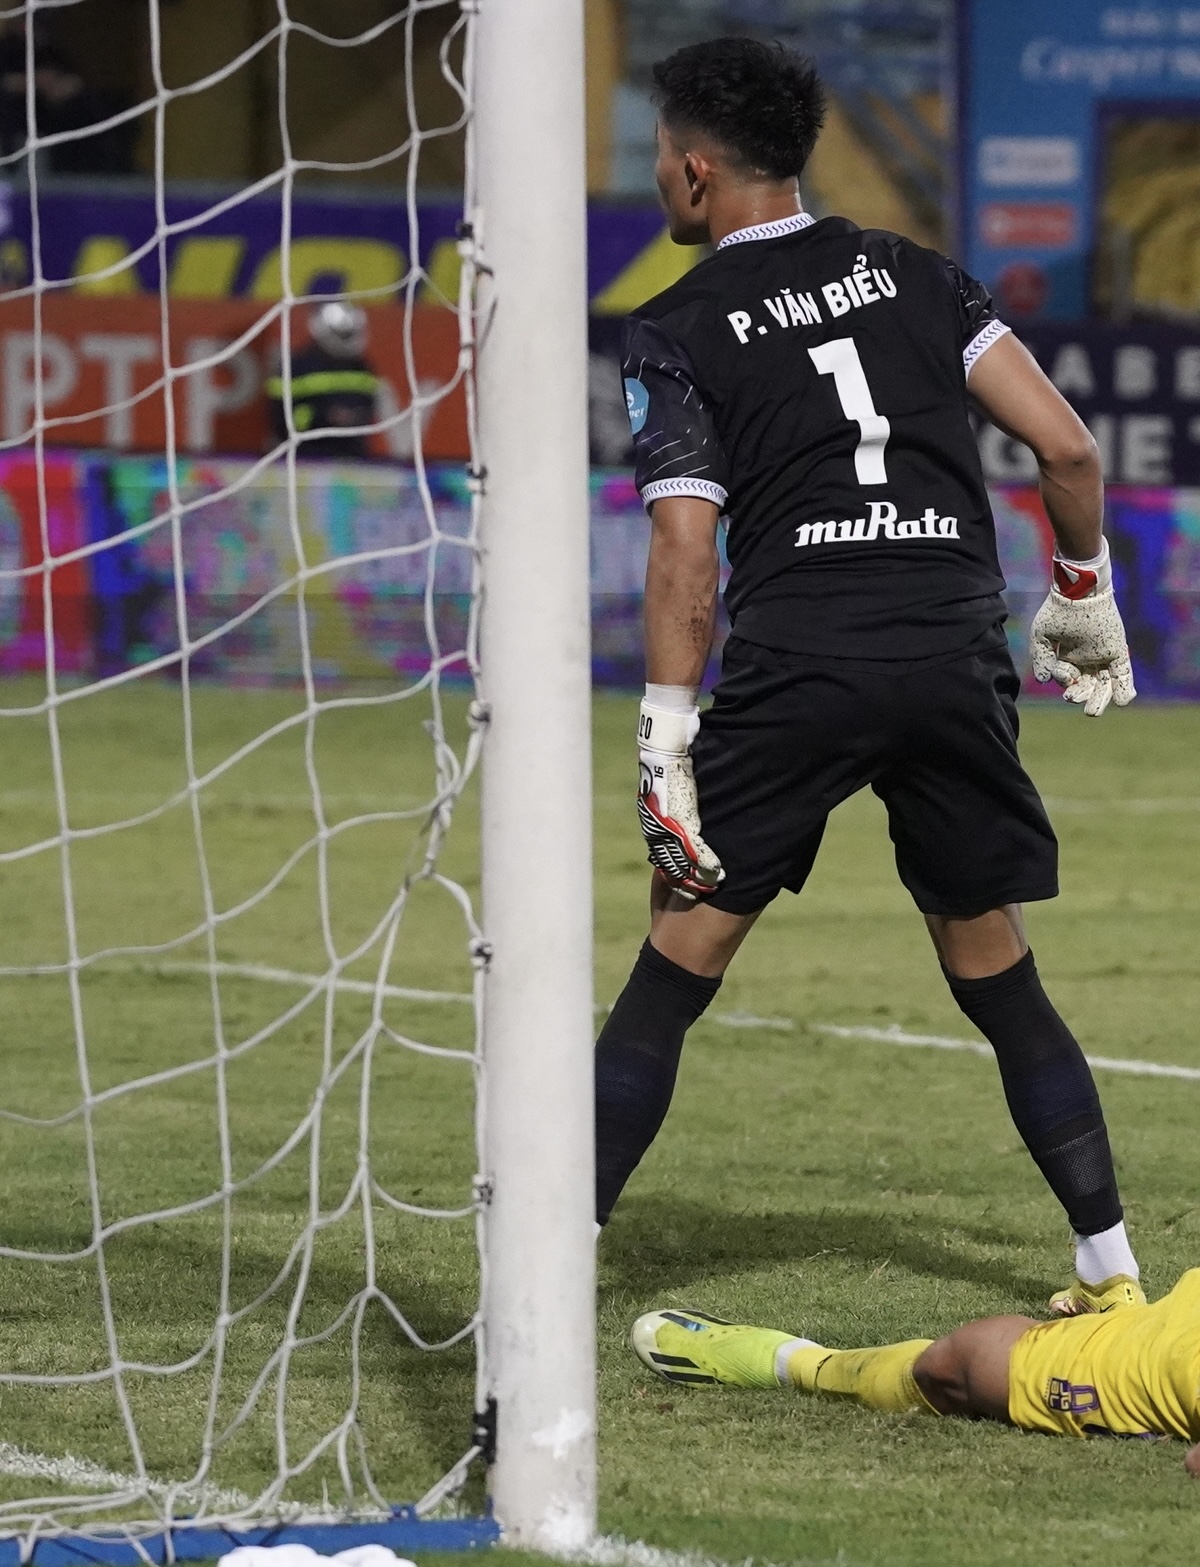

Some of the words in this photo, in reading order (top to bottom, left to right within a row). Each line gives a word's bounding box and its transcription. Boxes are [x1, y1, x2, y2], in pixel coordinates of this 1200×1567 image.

[727, 310, 768, 344] P.
[763, 288, 823, 328] VĂN
[821, 254, 897, 318] BIỂU
[807, 337, 891, 486] 1
